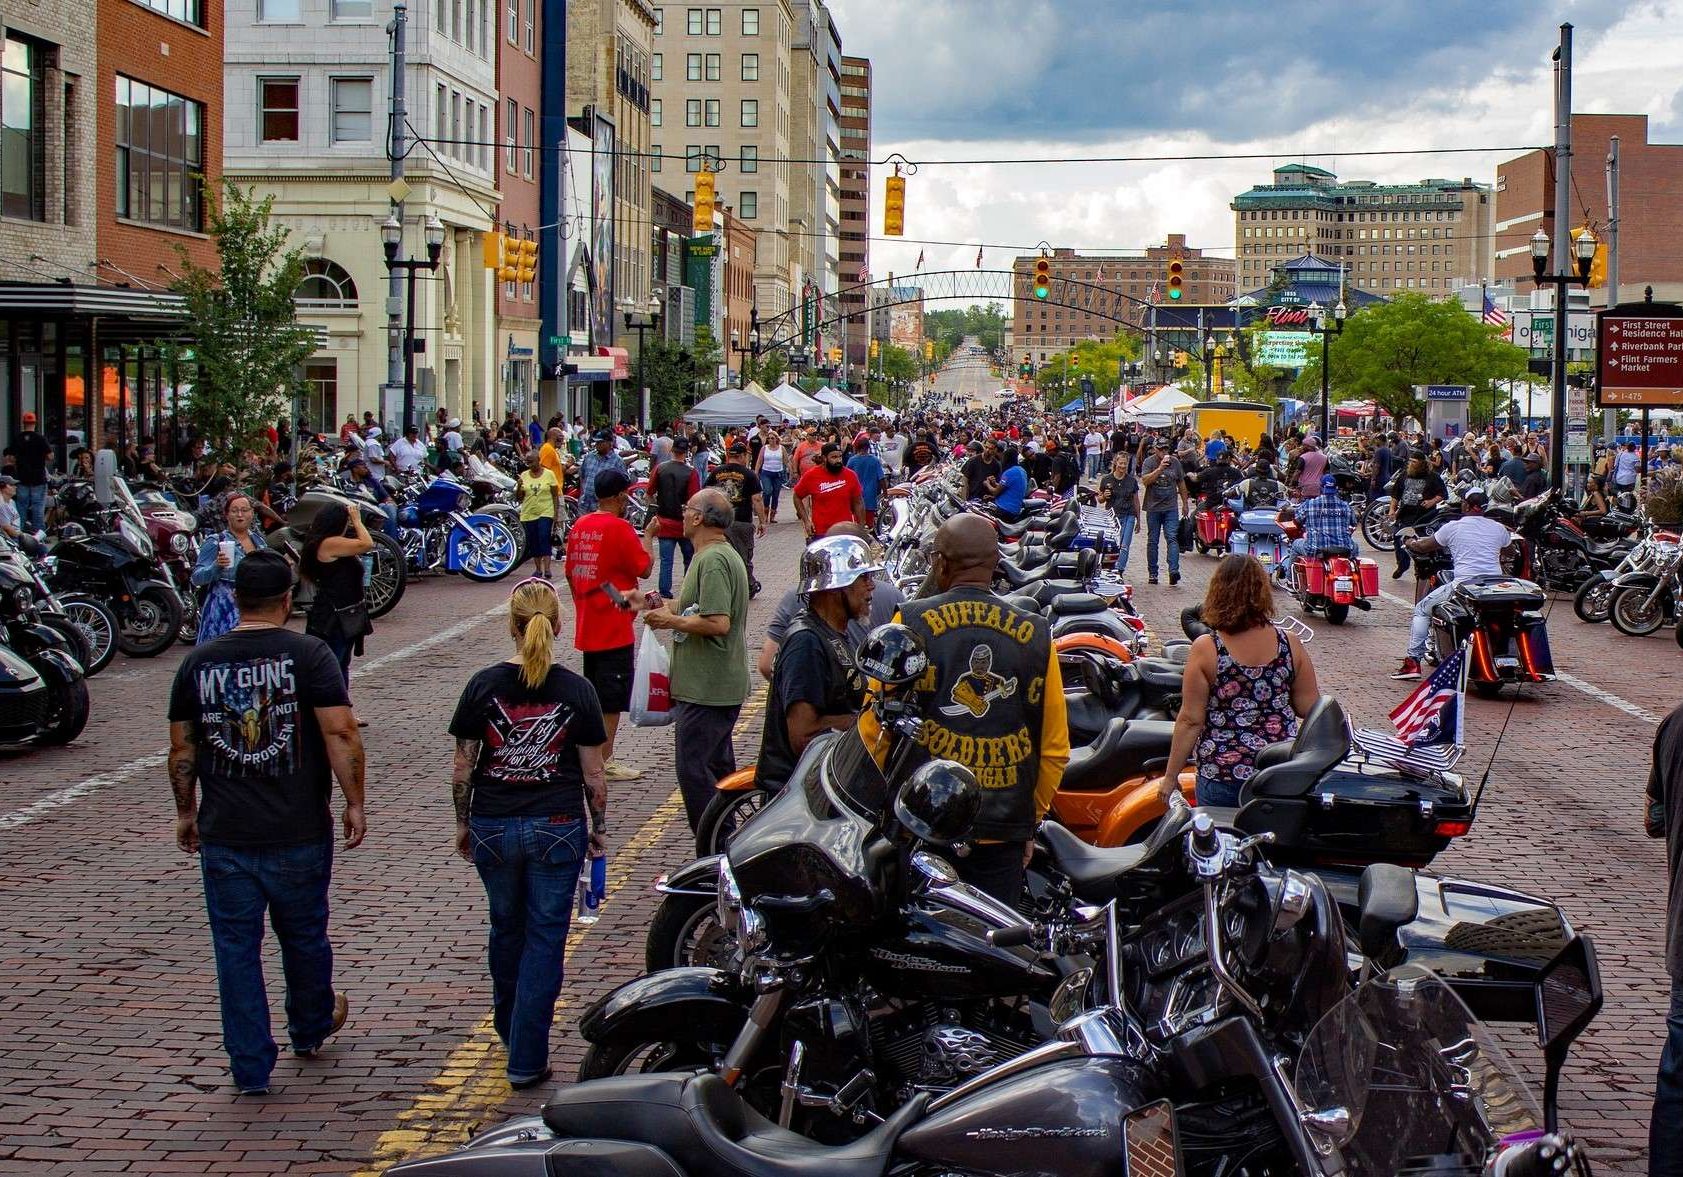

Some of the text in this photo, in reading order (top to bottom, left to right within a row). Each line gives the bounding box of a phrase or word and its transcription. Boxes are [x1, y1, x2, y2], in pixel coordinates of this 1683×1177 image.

[1265, 305, 1308, 325] Flint
[1622, 321, 1671, 330] First Street
[1622, 329, 1666, 338] Residence
[1621, 342, 1664, 351] Riverbank
[1620, 355, 1679, 364] Flint Farmers
[1620, 364, 1651, 372] Market
[1428, 389, 1436, 397] 24
[1437, 389, 1452, 397] hour
[1621, 392, 1642, 400] I-475
[921, 600, 1035, 645] BUFFALO
[200, 658, 296, 705] MY GUNS
[1027, 675, 1045, 704] C
[201, 701, 298, 723] ARE NOT
[242, 722, 295, 765] PROBLEM
[917, 718, 1033, 767] SOLDIERS
